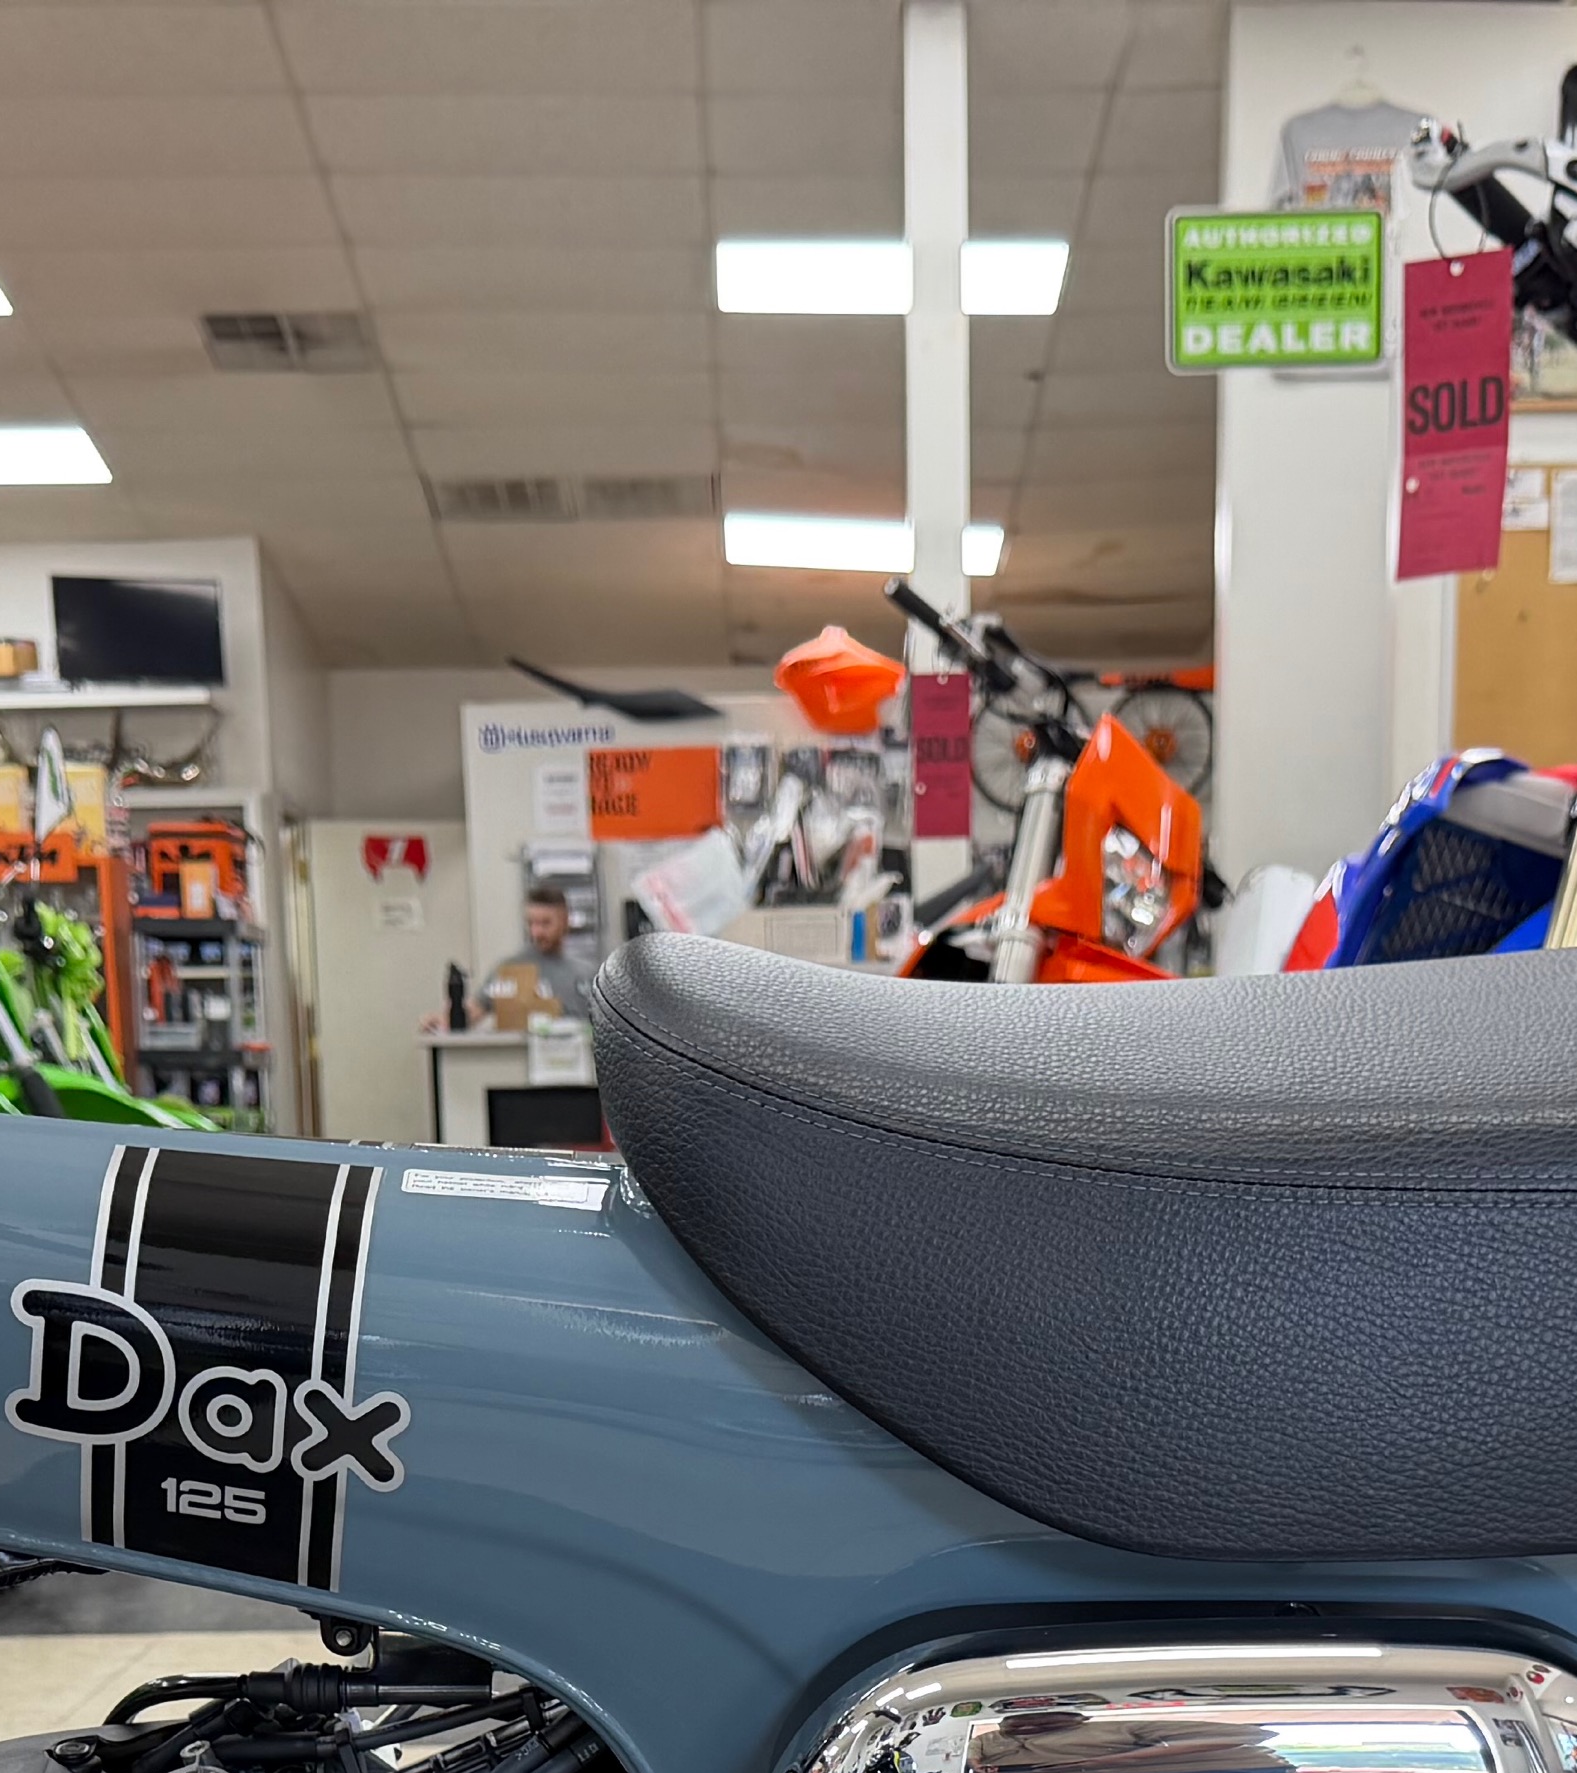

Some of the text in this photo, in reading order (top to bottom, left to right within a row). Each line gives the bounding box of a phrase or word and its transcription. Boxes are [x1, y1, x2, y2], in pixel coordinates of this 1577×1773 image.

[1184, 223, 1372, 249] AUTHORIZED
[1185, 254, 1371, 290] Kawasaki
[1184, 319, 1370, 356] DEALER
[1407, 376, 1505, 436] SOLD
[4, 1278, 412, 1494] Dax
[160, 1476, 267, 1525] 125
